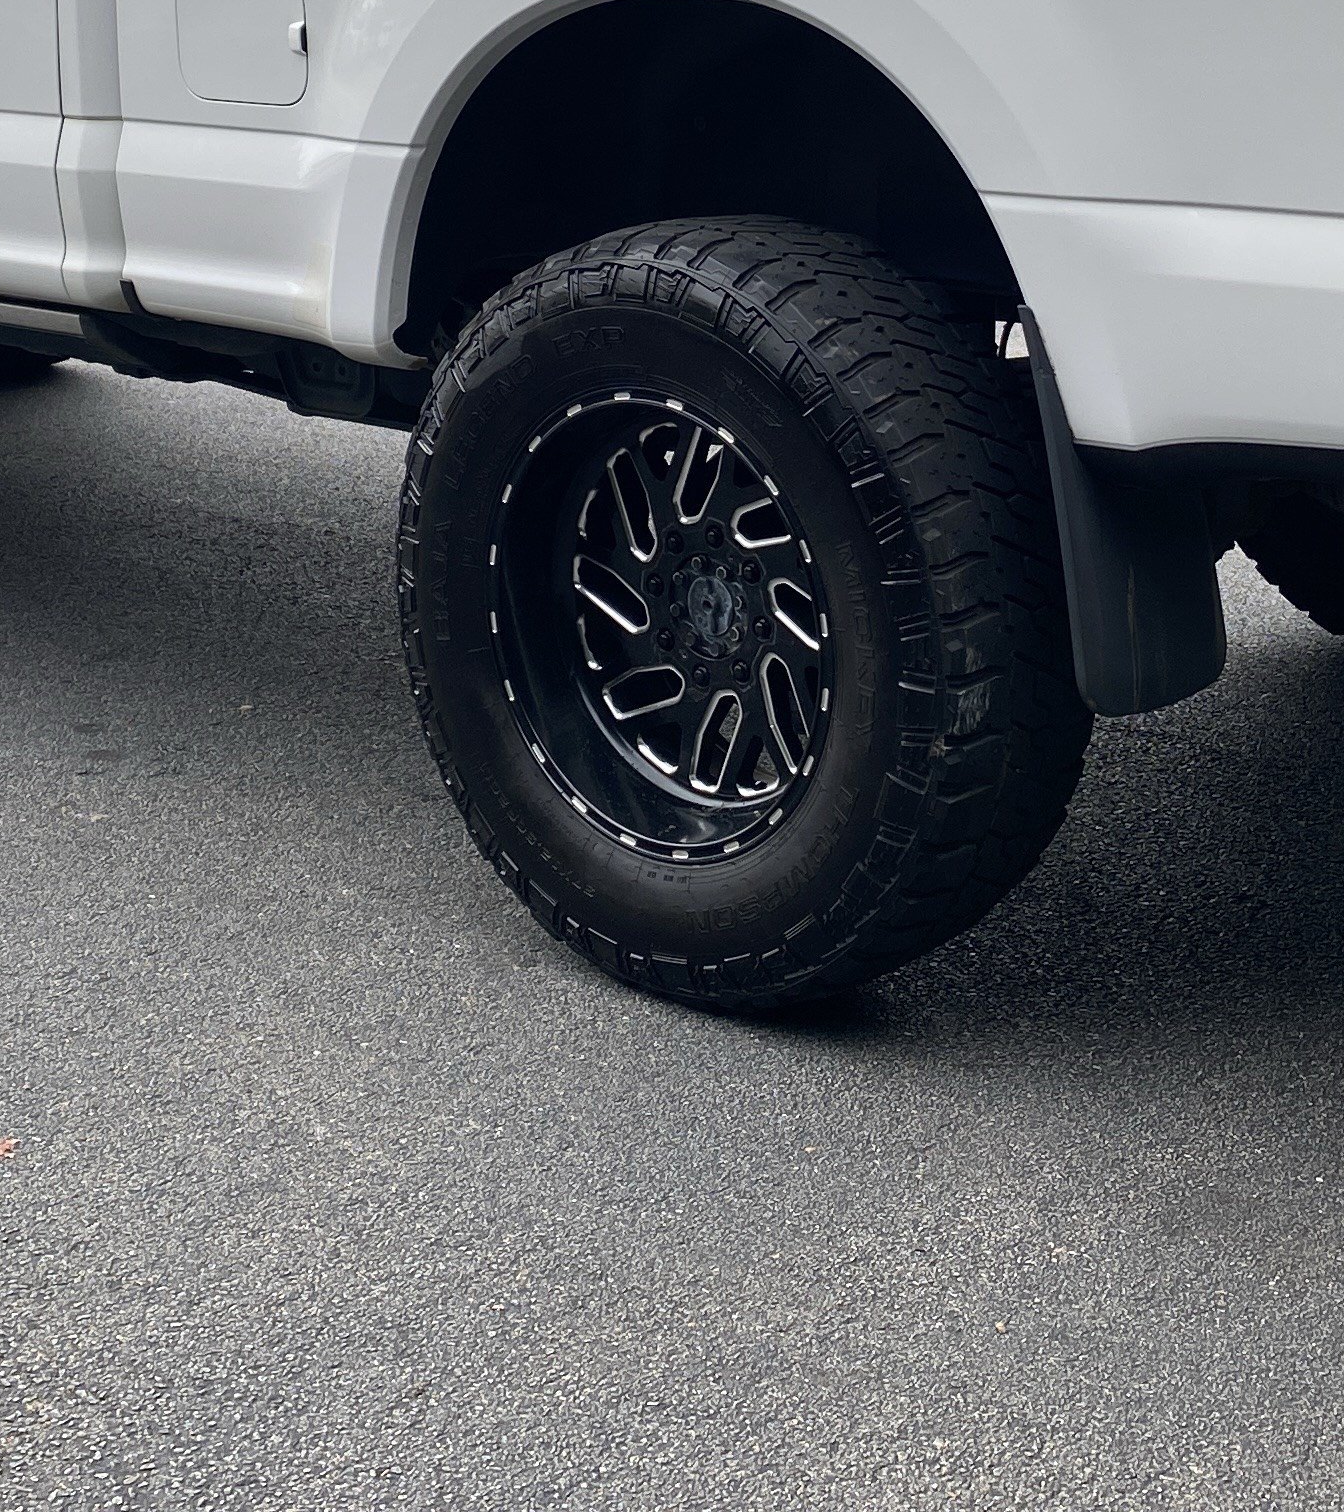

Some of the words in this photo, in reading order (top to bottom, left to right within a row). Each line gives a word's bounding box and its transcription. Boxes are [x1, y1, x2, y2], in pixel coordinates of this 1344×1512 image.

[553, 324, 626, 358] EXP
[834, 540, 877, 754] MICKEY
[686, 784, 860, 934] THOMPSON
